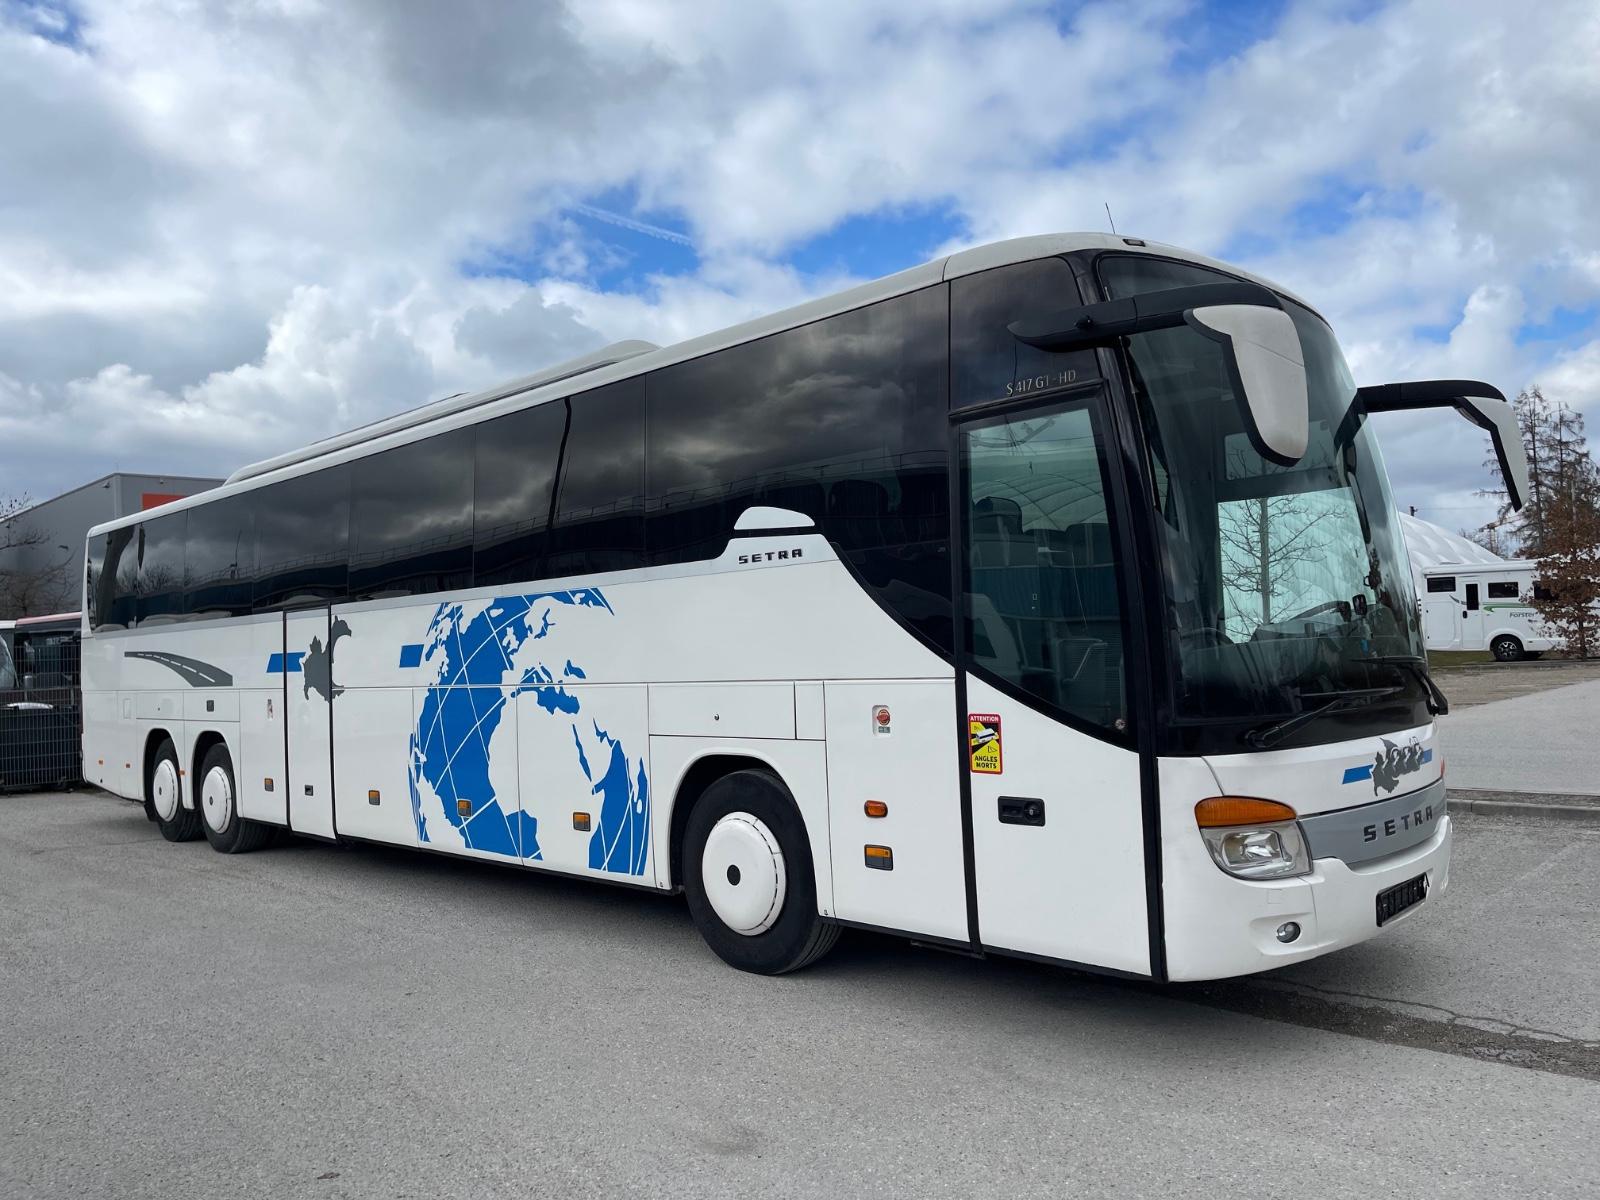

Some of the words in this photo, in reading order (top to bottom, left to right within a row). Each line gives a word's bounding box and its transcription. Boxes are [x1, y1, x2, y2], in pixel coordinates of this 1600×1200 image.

[1006, 382, 1014, 395] S
[1015, 378, 1033, 393] 417
[738, 548, 803, 565] SETRA
[975, 755, 998, 763] ANGLES
[1363, 805, 1433, 843] SETRA
